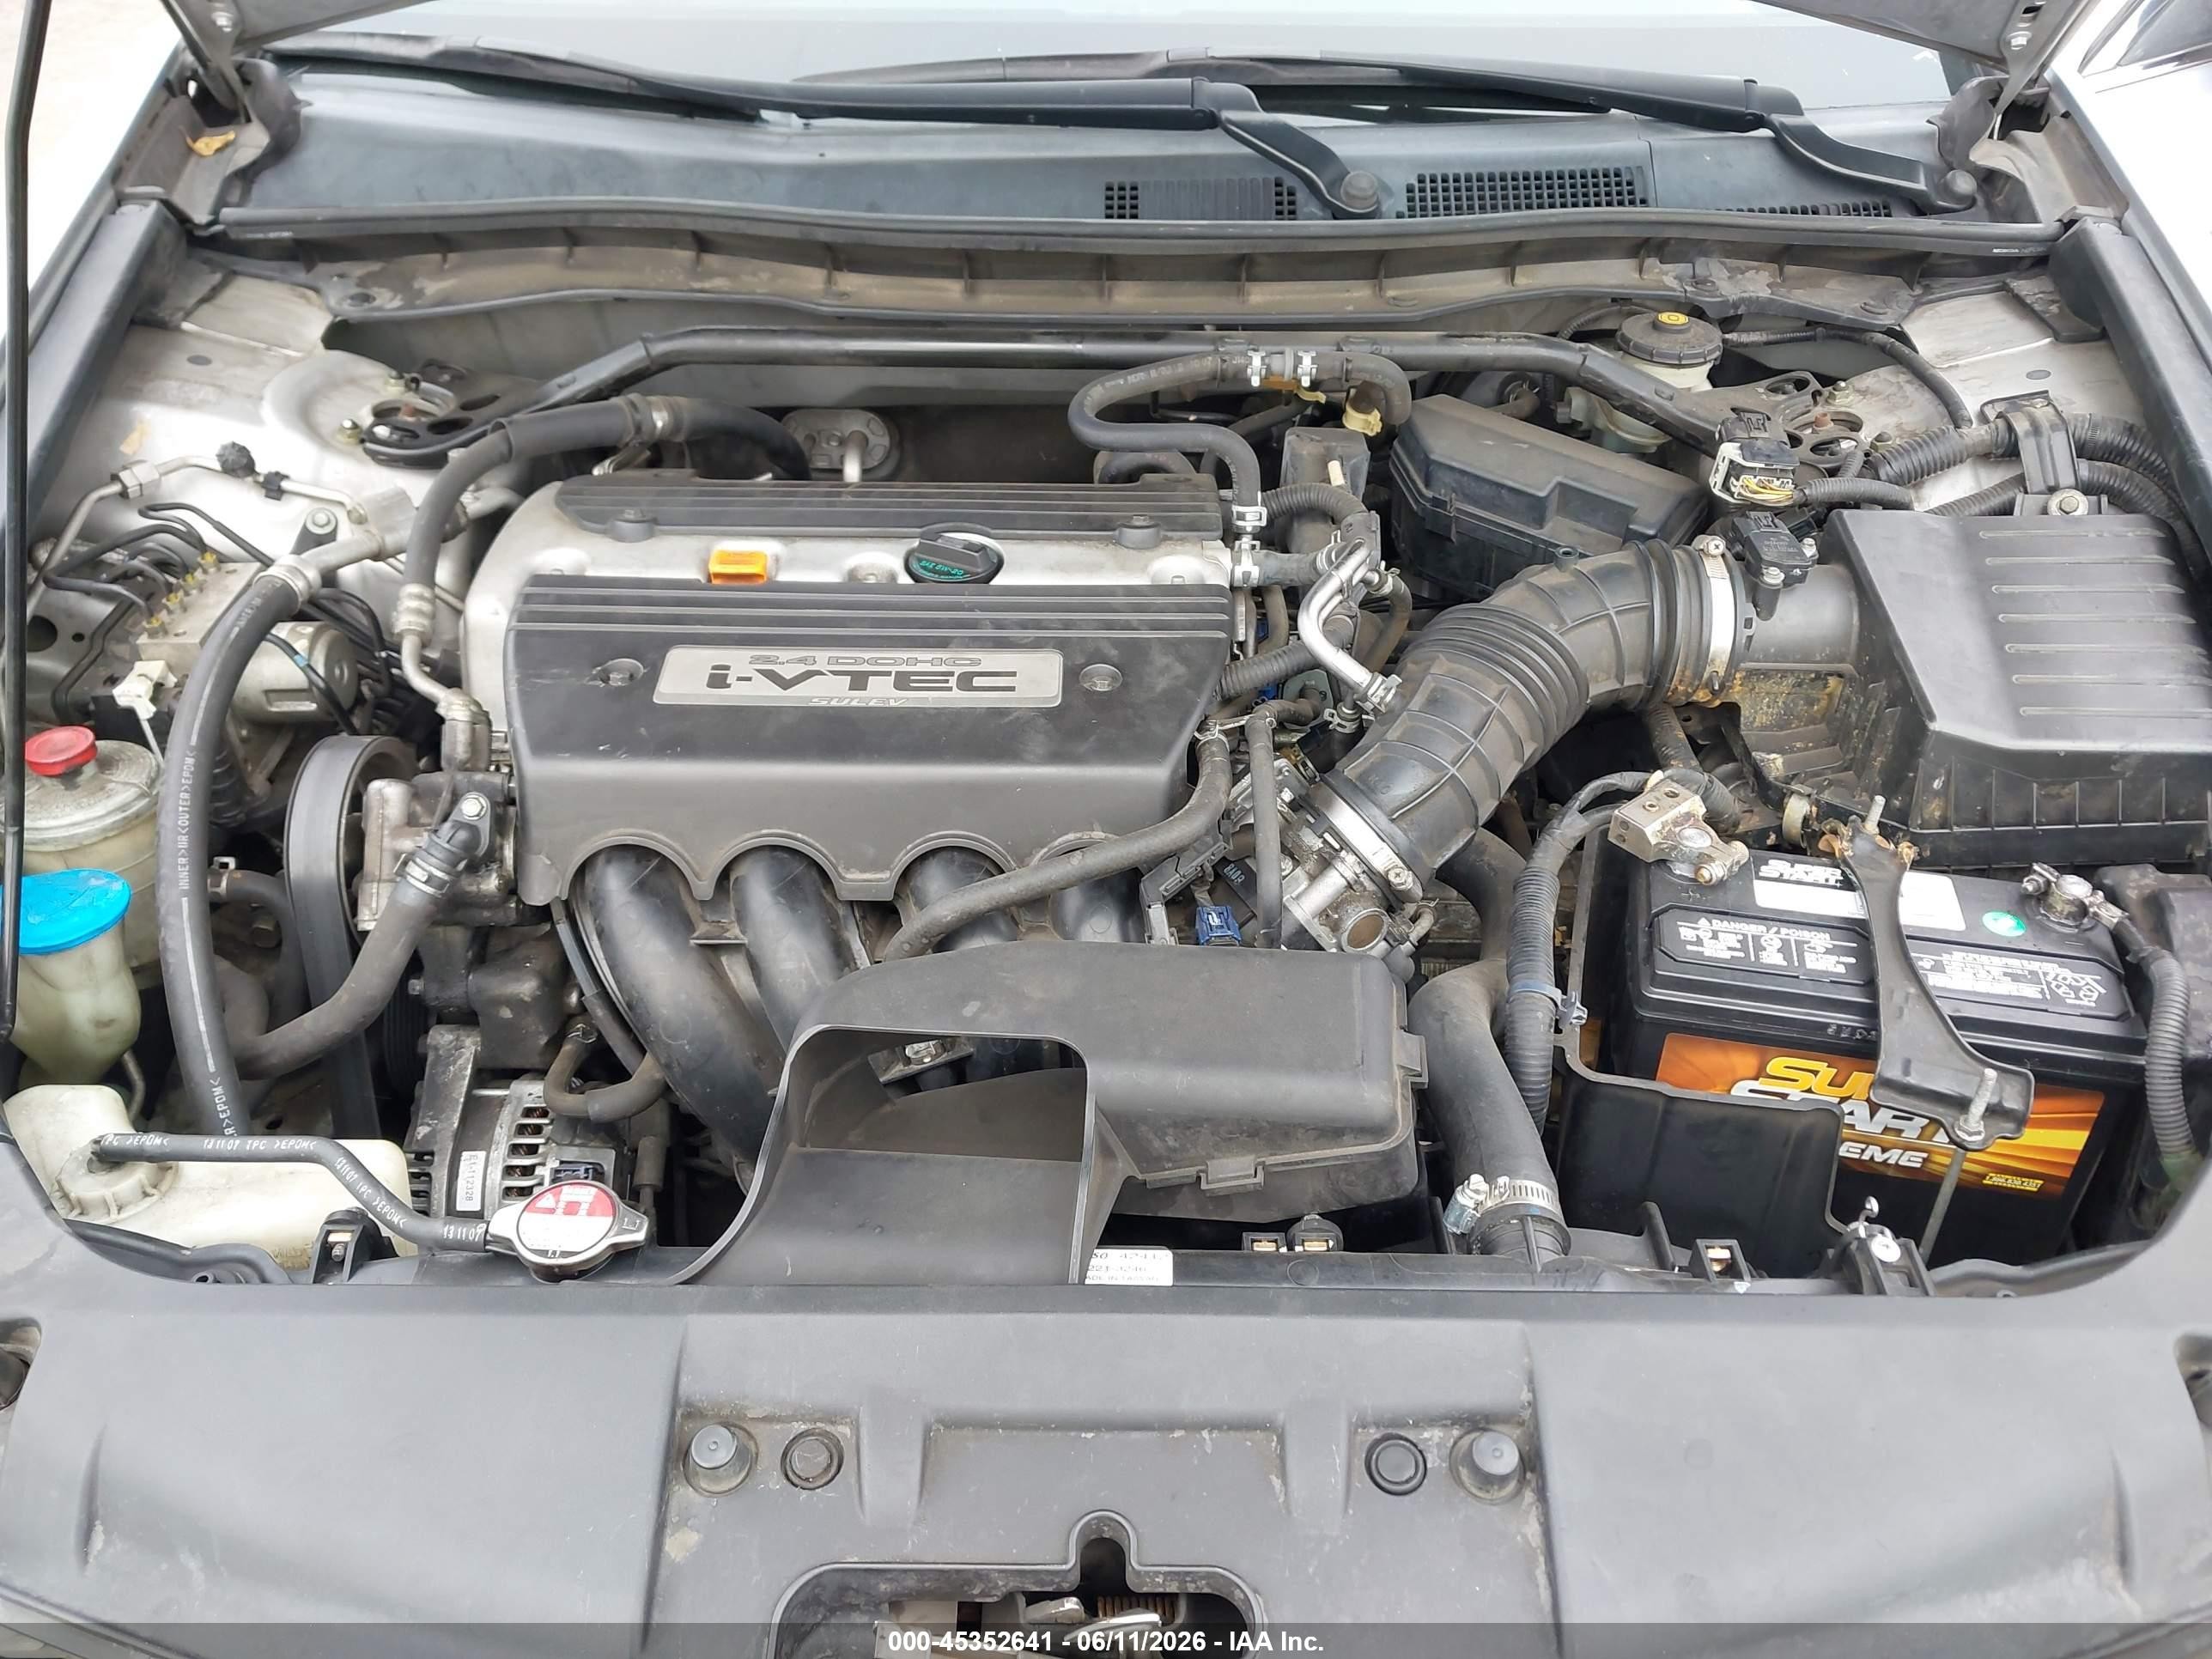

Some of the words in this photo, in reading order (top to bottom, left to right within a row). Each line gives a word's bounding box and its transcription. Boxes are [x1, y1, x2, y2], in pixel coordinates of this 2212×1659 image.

[749, 654, 817, 665] 2.4
[827, 656, 981, 666] DOHC
[706, 664, 1018, 692] i-VTEC
[808, 696, 908, 708] SULEV
[1711, 919, 1767, 933] DANGER
[1779, 927, 1830, 941] POISON
